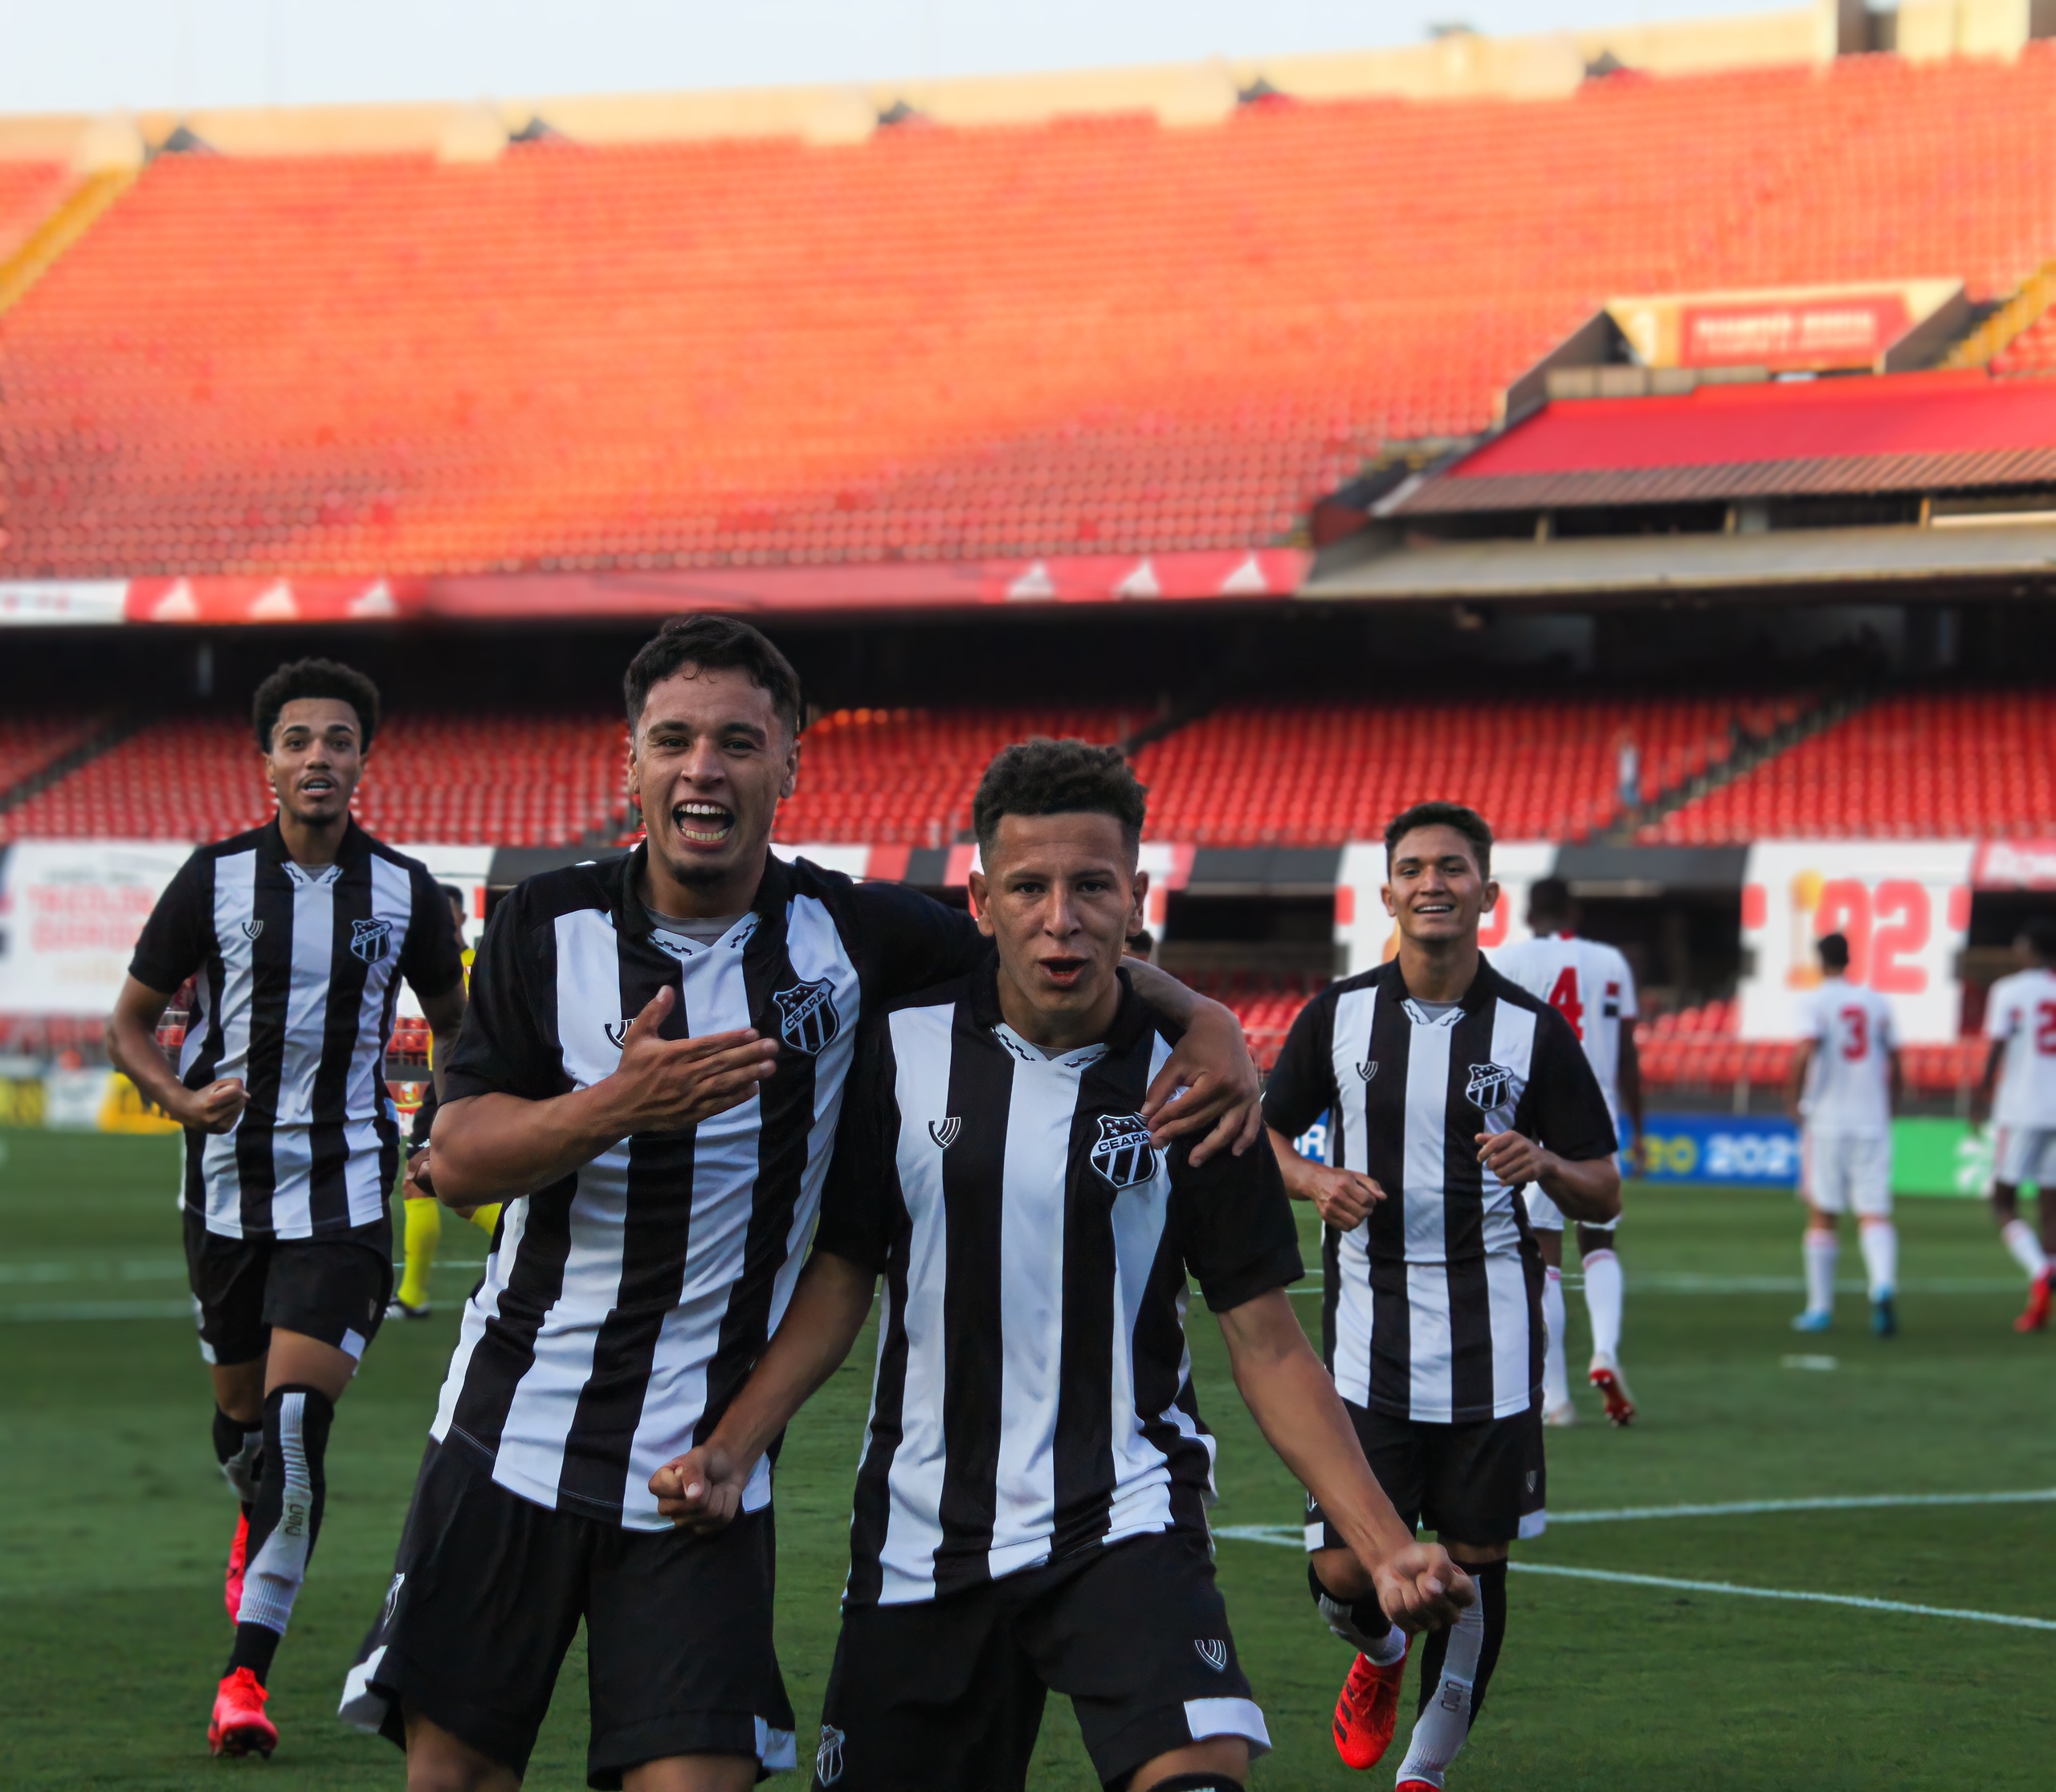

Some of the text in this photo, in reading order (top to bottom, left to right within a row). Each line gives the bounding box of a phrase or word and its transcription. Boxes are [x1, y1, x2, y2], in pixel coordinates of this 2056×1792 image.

[1548, 966, 1584, 1043] 4
[1840, 1004, 1868, 1062] 3
[1706, 1133, 1801, 1176] 202
